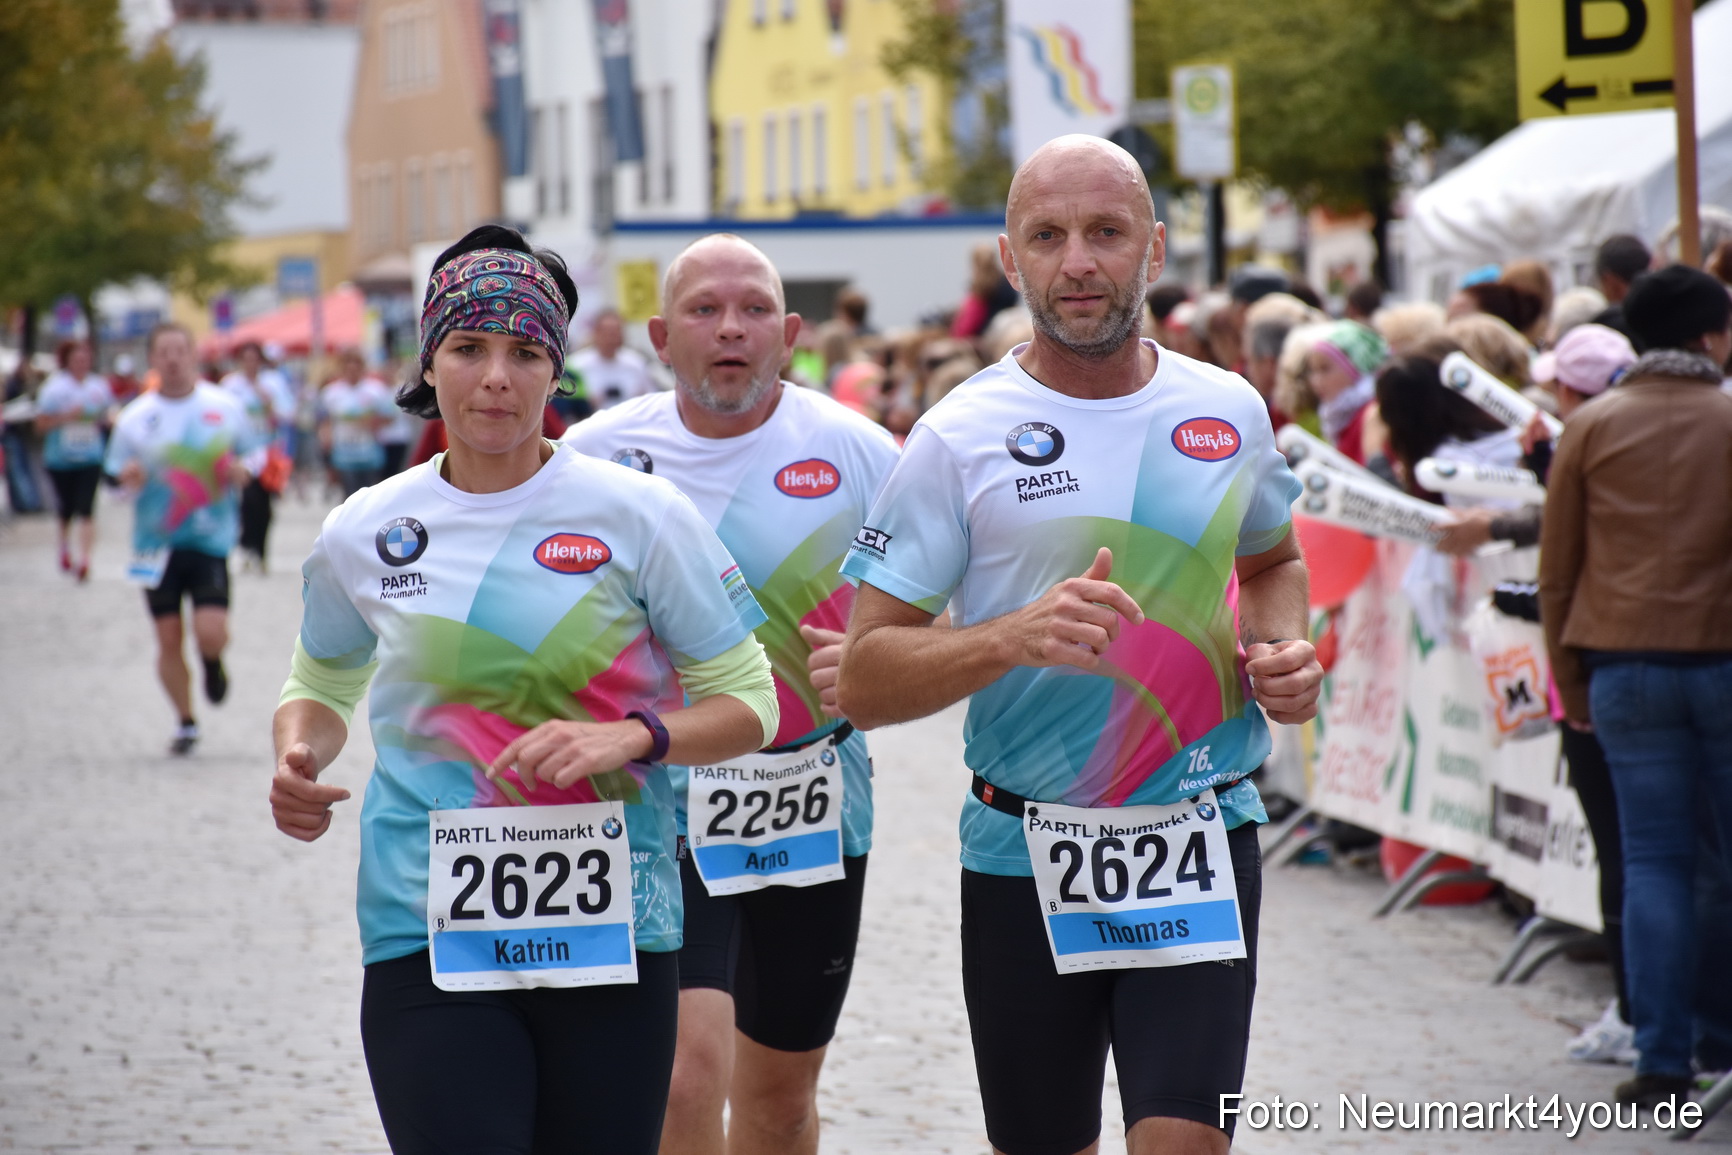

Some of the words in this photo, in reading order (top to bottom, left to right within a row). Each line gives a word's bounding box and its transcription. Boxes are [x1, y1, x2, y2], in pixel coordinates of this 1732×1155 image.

[1008, 423, 1055, 441] BMW
[1181, 429, 1234, 450] Hervis
[784, 469, 834, 488] Hervis
[1015, 470, 1077, 491] PARTL
[1018, 483, 1080, 503] Neumarkt
[379, 518, 423, 536] BMW
[851, 544, 868, 554] mart
[858, 529, 888, 551] CK
[545, 542, 603, 563] Hervis
[381, 572, 428, 591] PARTL
[380, 586, 427, 600] Neumarkt
[694, 767, 749, 781] PARTL
[753, 758, 818, 782] Neumarkt
[1187, 745, 1214, 774] 16.
[706, 776, 830, 839] 2256
[435, 827, 496, 844] PARTL
[502, 823, 595, 843] Neumarkt
[1029, 818, 1095, 838] PARTL
[1100, 812, 1191, 838] Neumarkt
[631, 851, 652, 864] ter
[745, 850, 789, 871] Arno
[1050, 831, 1216, 904] 2624
[450, 849, 612, 921] 2623
[1092, 919, 1190, 944] Thomas
[494, 937, 570, 965] Katrin
